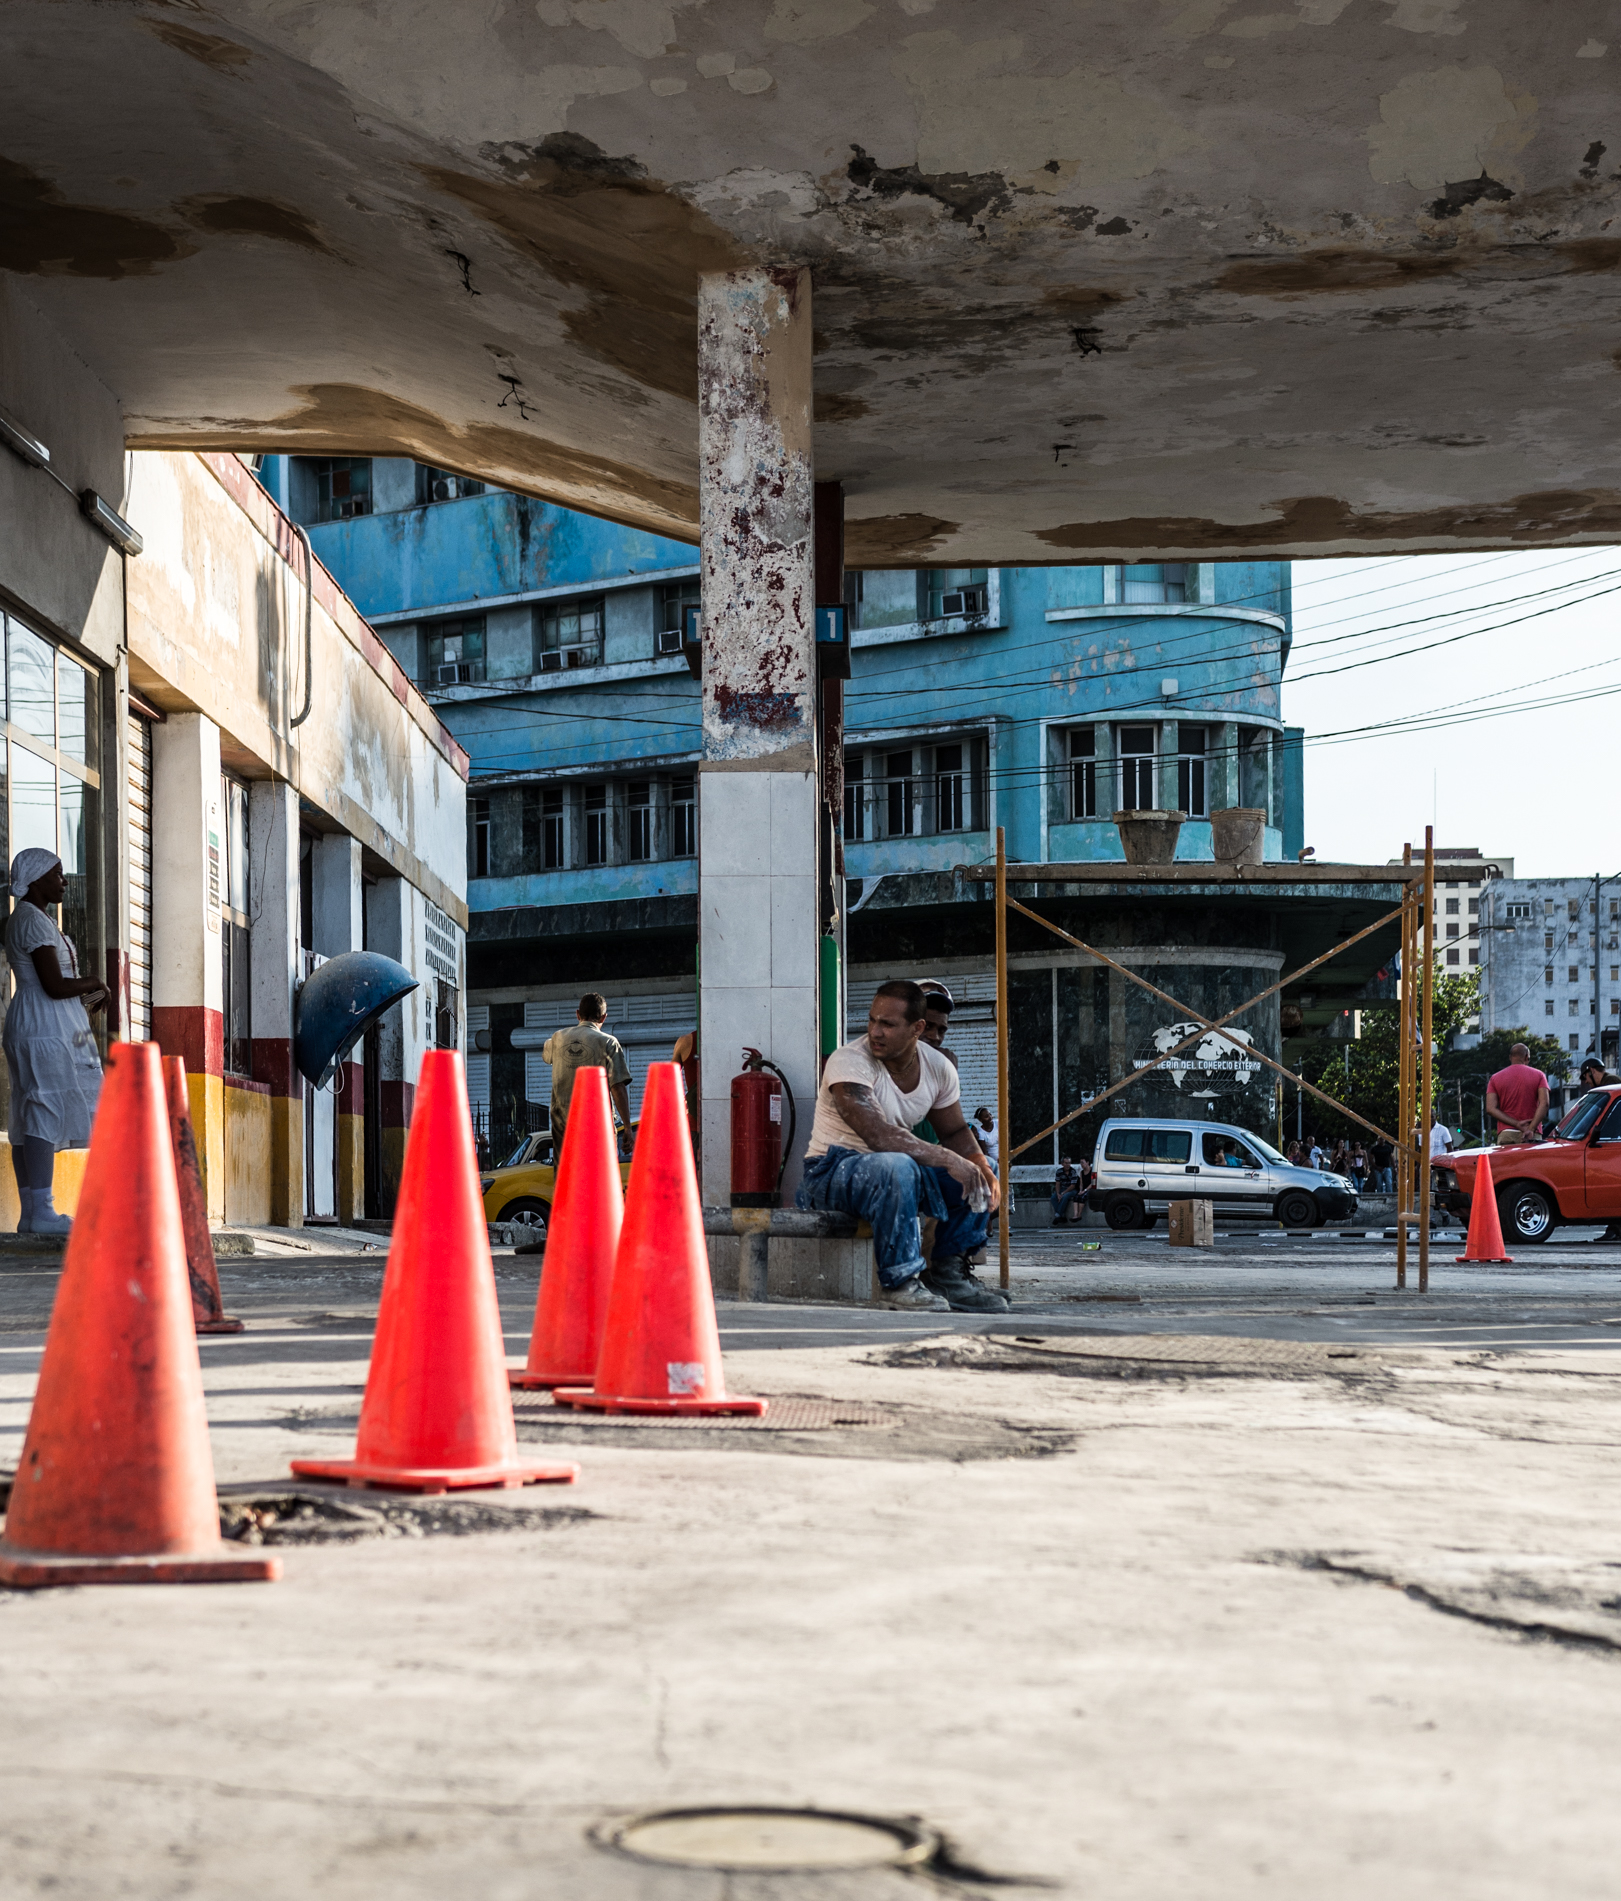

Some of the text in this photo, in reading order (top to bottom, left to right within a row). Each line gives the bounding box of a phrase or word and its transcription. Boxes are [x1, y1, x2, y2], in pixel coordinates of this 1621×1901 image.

[693, 612, 702, 639] 1
[827, 611, 836, 638] 1
[1181, 1060, 1197, 1070] DEL
[1198, 1060, 1233, 1070] COMERCIO
[1234, 1061, 1261, 1071] EXTERIOR
